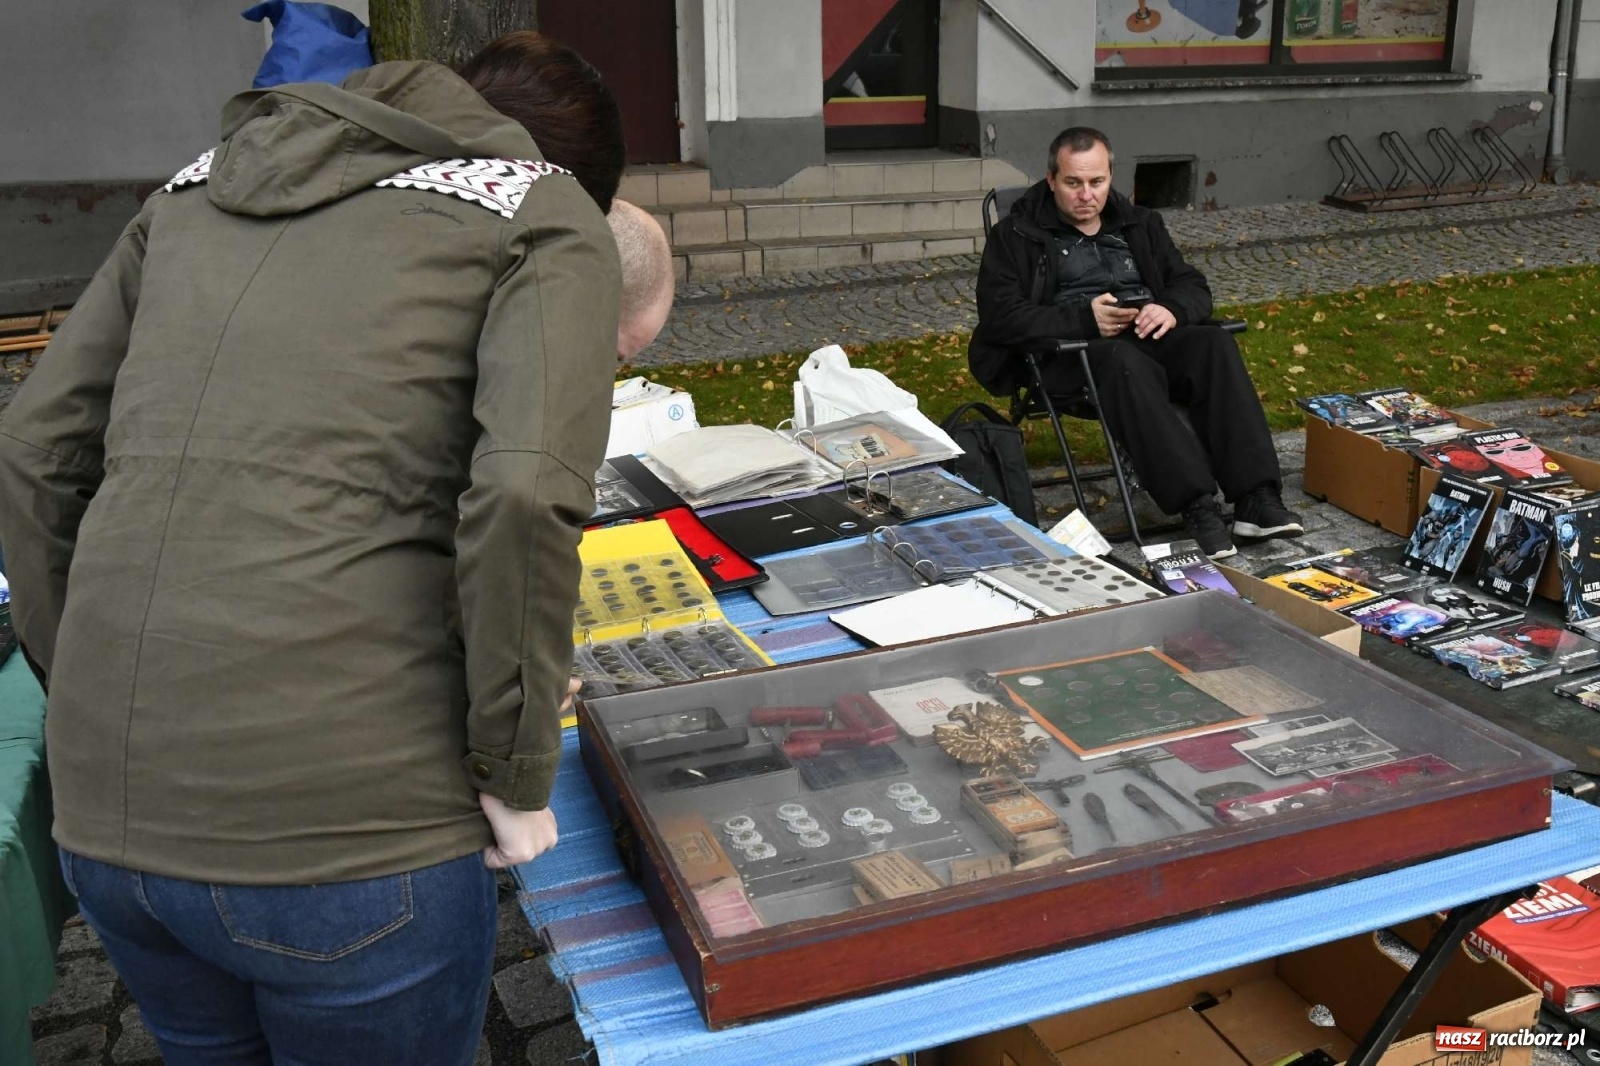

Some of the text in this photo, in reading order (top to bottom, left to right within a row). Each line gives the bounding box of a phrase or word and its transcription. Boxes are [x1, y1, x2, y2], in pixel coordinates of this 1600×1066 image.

[1449, 489, 1471, 503] BATMAN
[1508, 499, 1548, 523] BATMAN
[1492, 577, 1512, 593] HUSH
[1502, 892, 1584, 919] ZIEMI
[1469, 931, 1508, 963] ZIEMI
